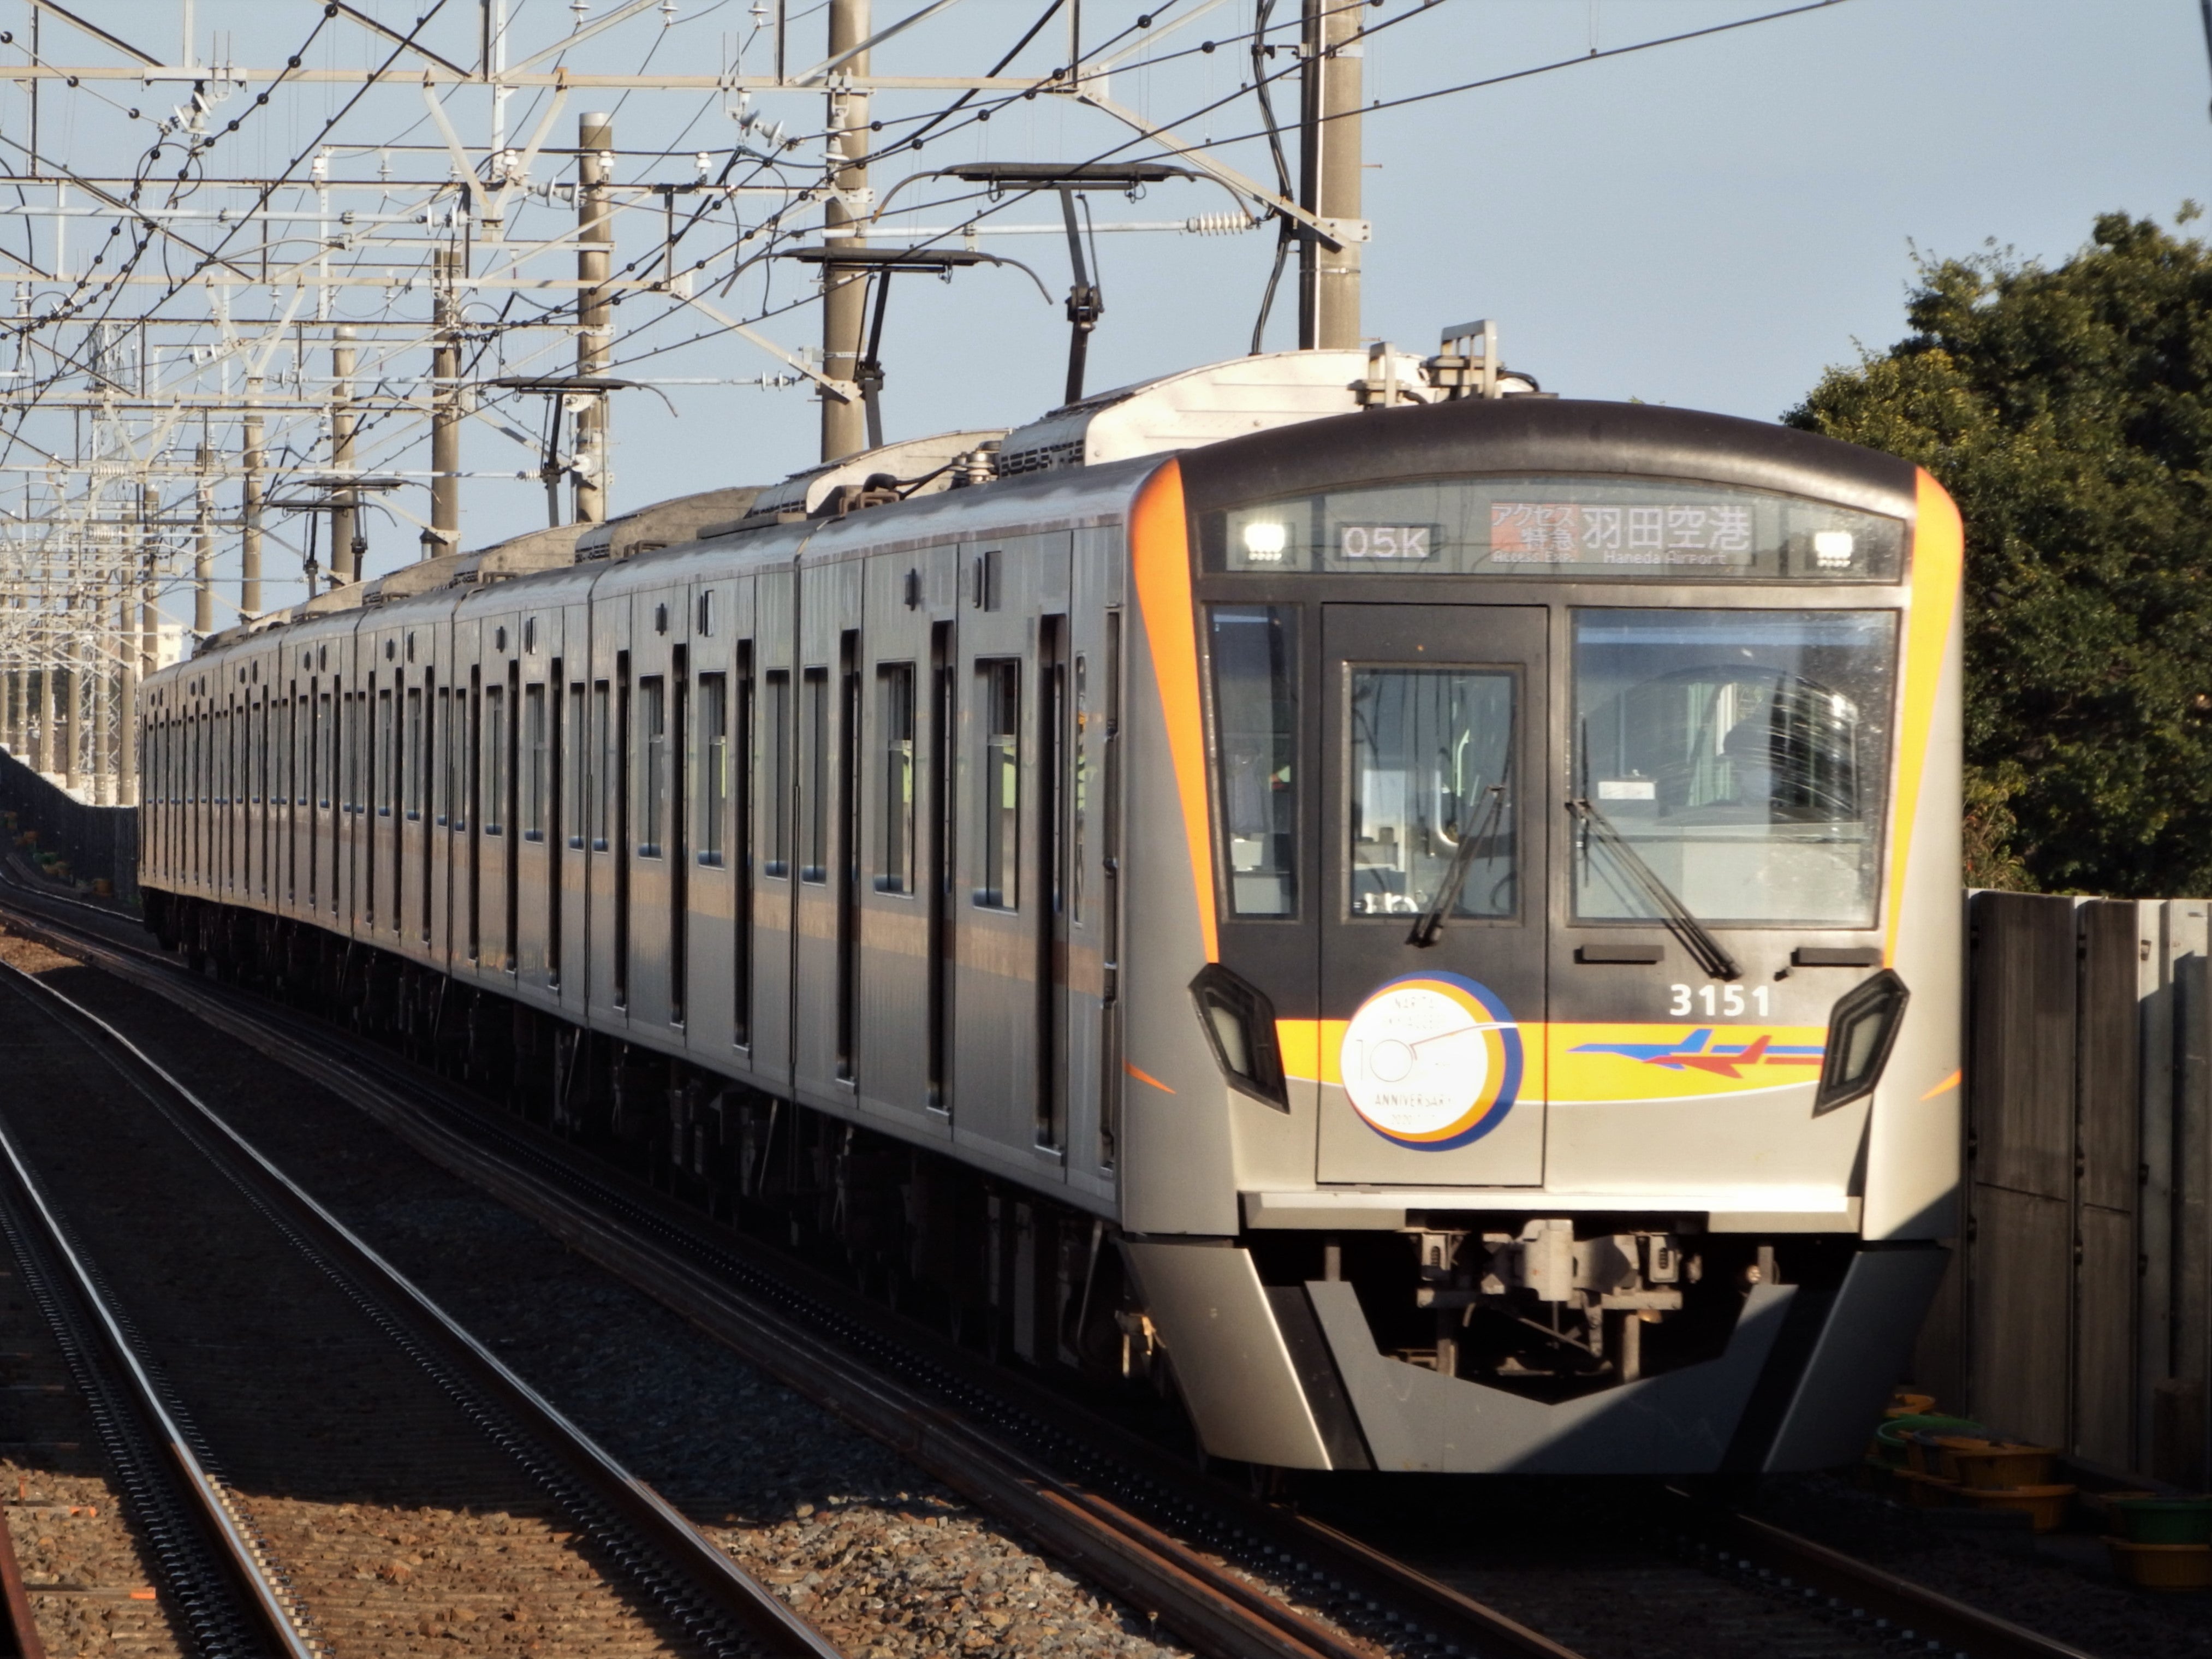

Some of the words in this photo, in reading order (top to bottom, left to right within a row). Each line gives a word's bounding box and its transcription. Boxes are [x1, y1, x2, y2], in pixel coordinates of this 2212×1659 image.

[1491, 503, 1574, 526] アクセス
[1581, 505, 1750, 550] 羽田空港
[1345, 527, 1428, 557] 05K
[1520, 527, 1575, 550] 特急
[1604, 550, 1661, 564] Haneda
[1664, 550, 1726, 564] Airport
[1669, 984, 1769, 1016] 3151
